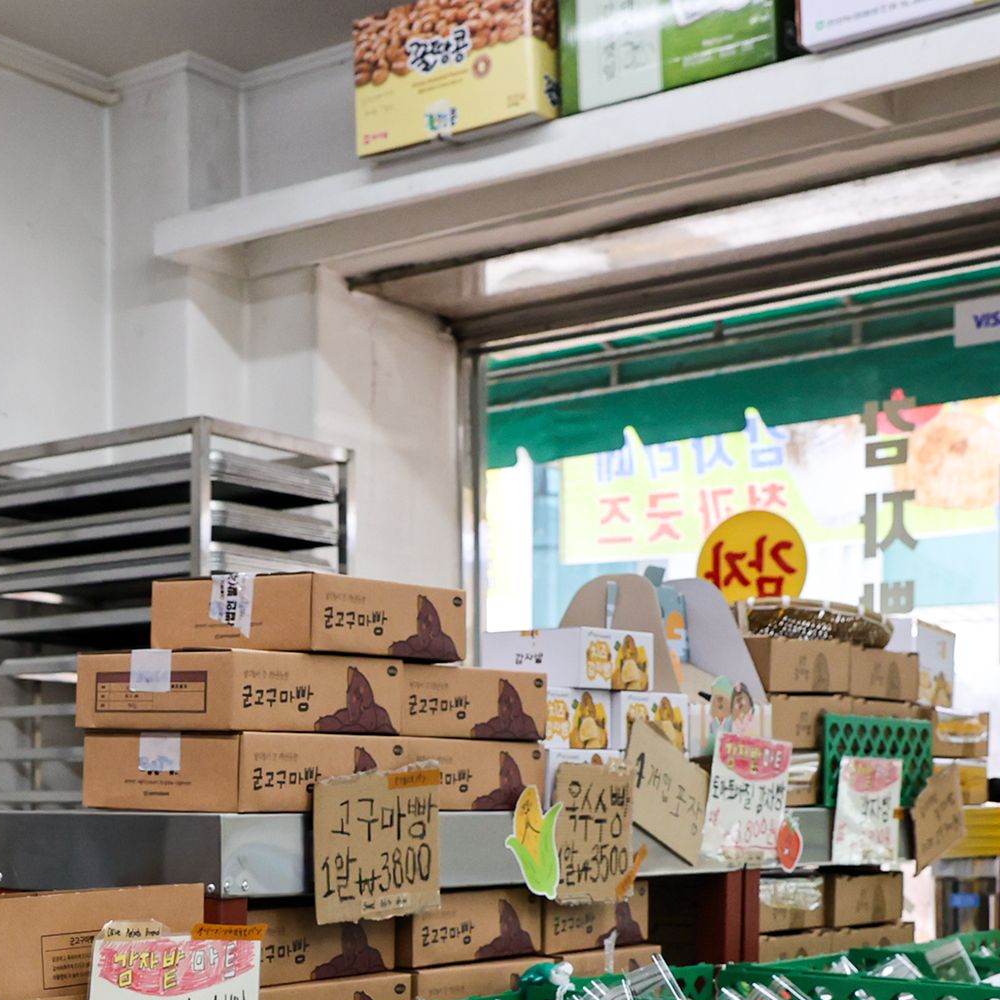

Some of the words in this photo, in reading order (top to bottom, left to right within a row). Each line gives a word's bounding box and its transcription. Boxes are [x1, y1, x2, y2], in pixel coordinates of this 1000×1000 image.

[331, 794, 438, 841] 고구마빵
[322, 847, 356, 902] 1알
[113, 946, 184, 990] 감자밭
[192, 941, 236, 979] 마트
